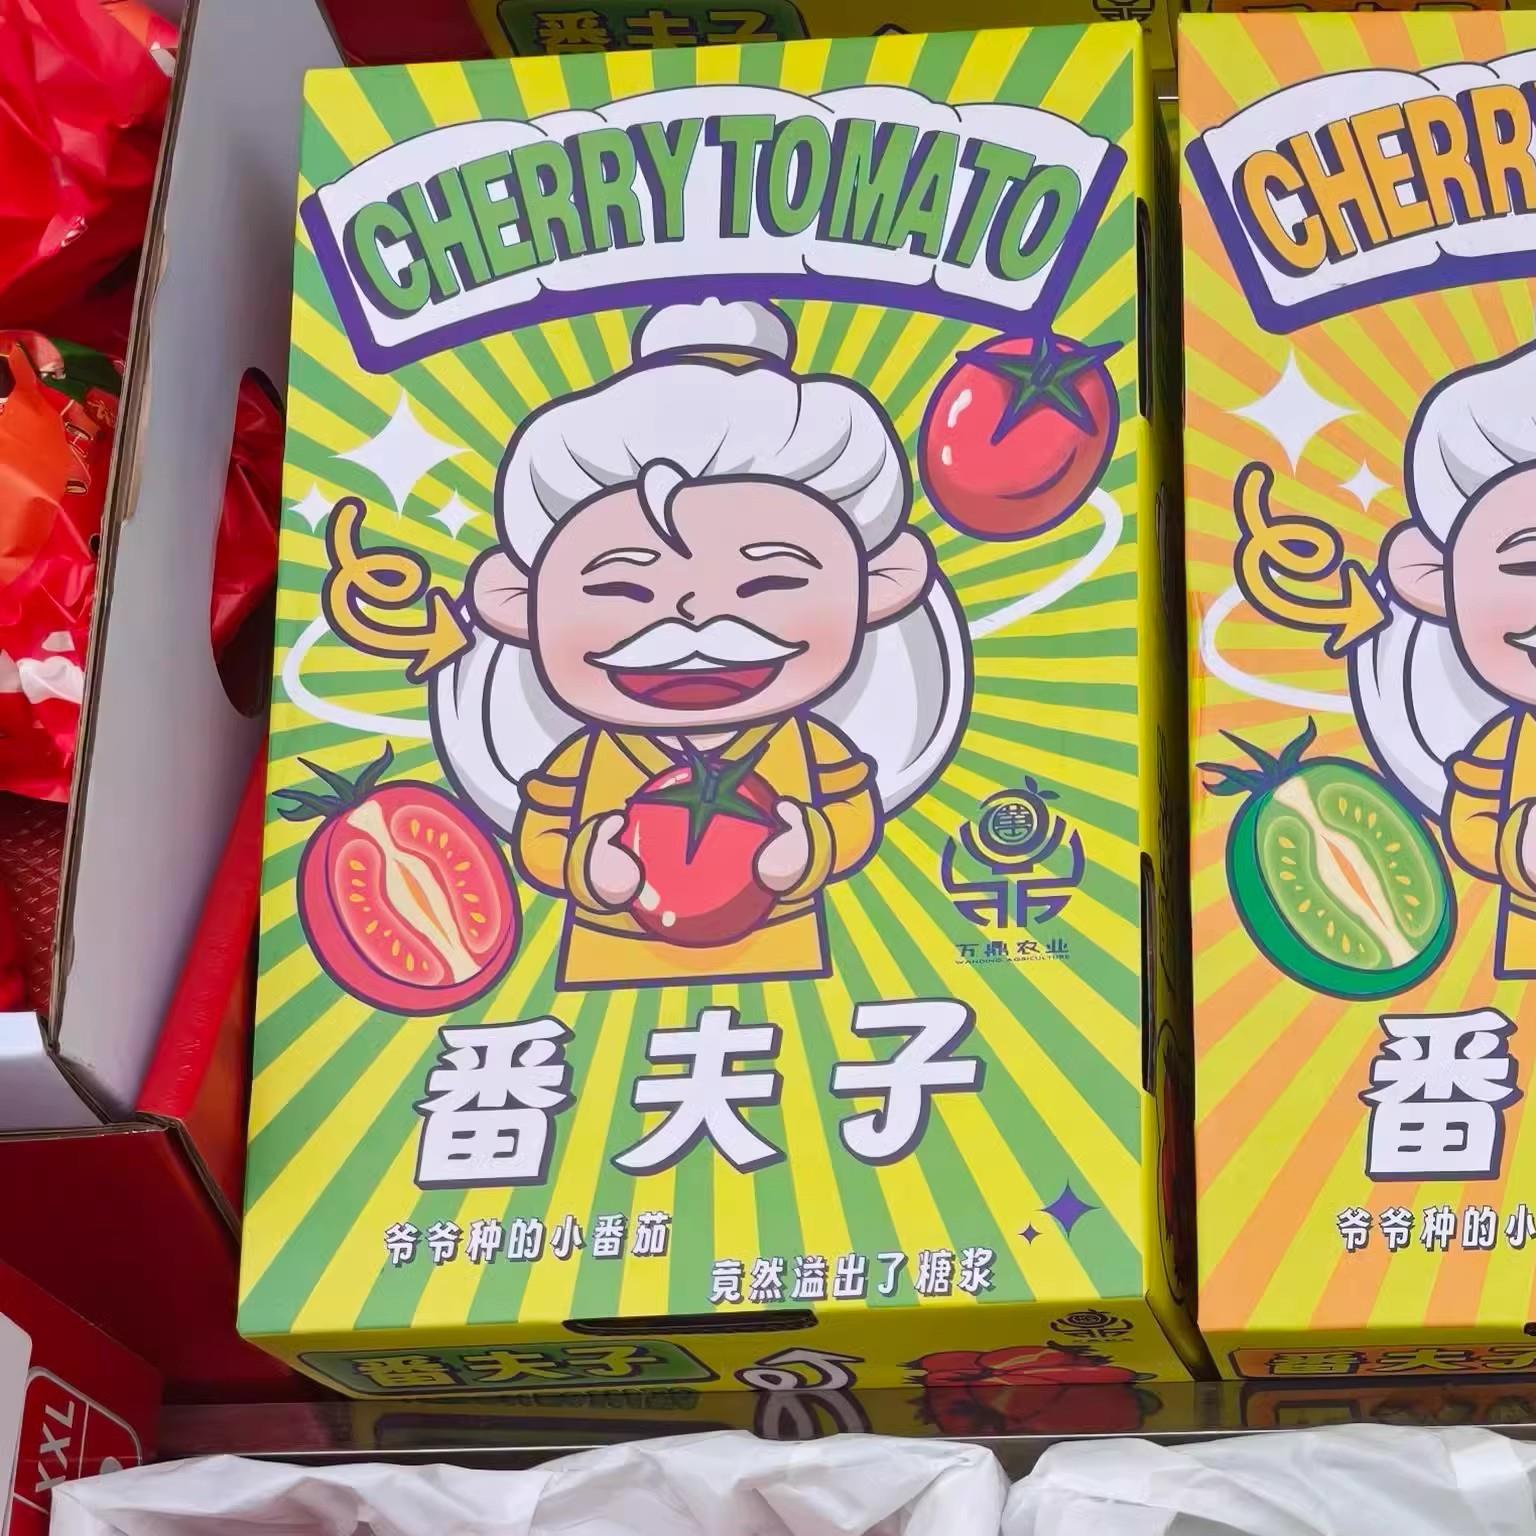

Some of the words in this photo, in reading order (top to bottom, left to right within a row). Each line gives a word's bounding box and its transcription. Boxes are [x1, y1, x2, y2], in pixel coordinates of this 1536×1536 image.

[343, 117, 704, 320] CHERRY
[705, 114, 1083, 283] TOMATO
[956, 938, 1070, 958] 万鼎农业
[413, 998, 985, 1191] 番夫子
[383, 1211, 674, 1265] 爷爷种的小番茄
[708, 1247, 998, 1306] 竟然溢出了糖浆
[352, 1345, 664, 1388] 番夫子
